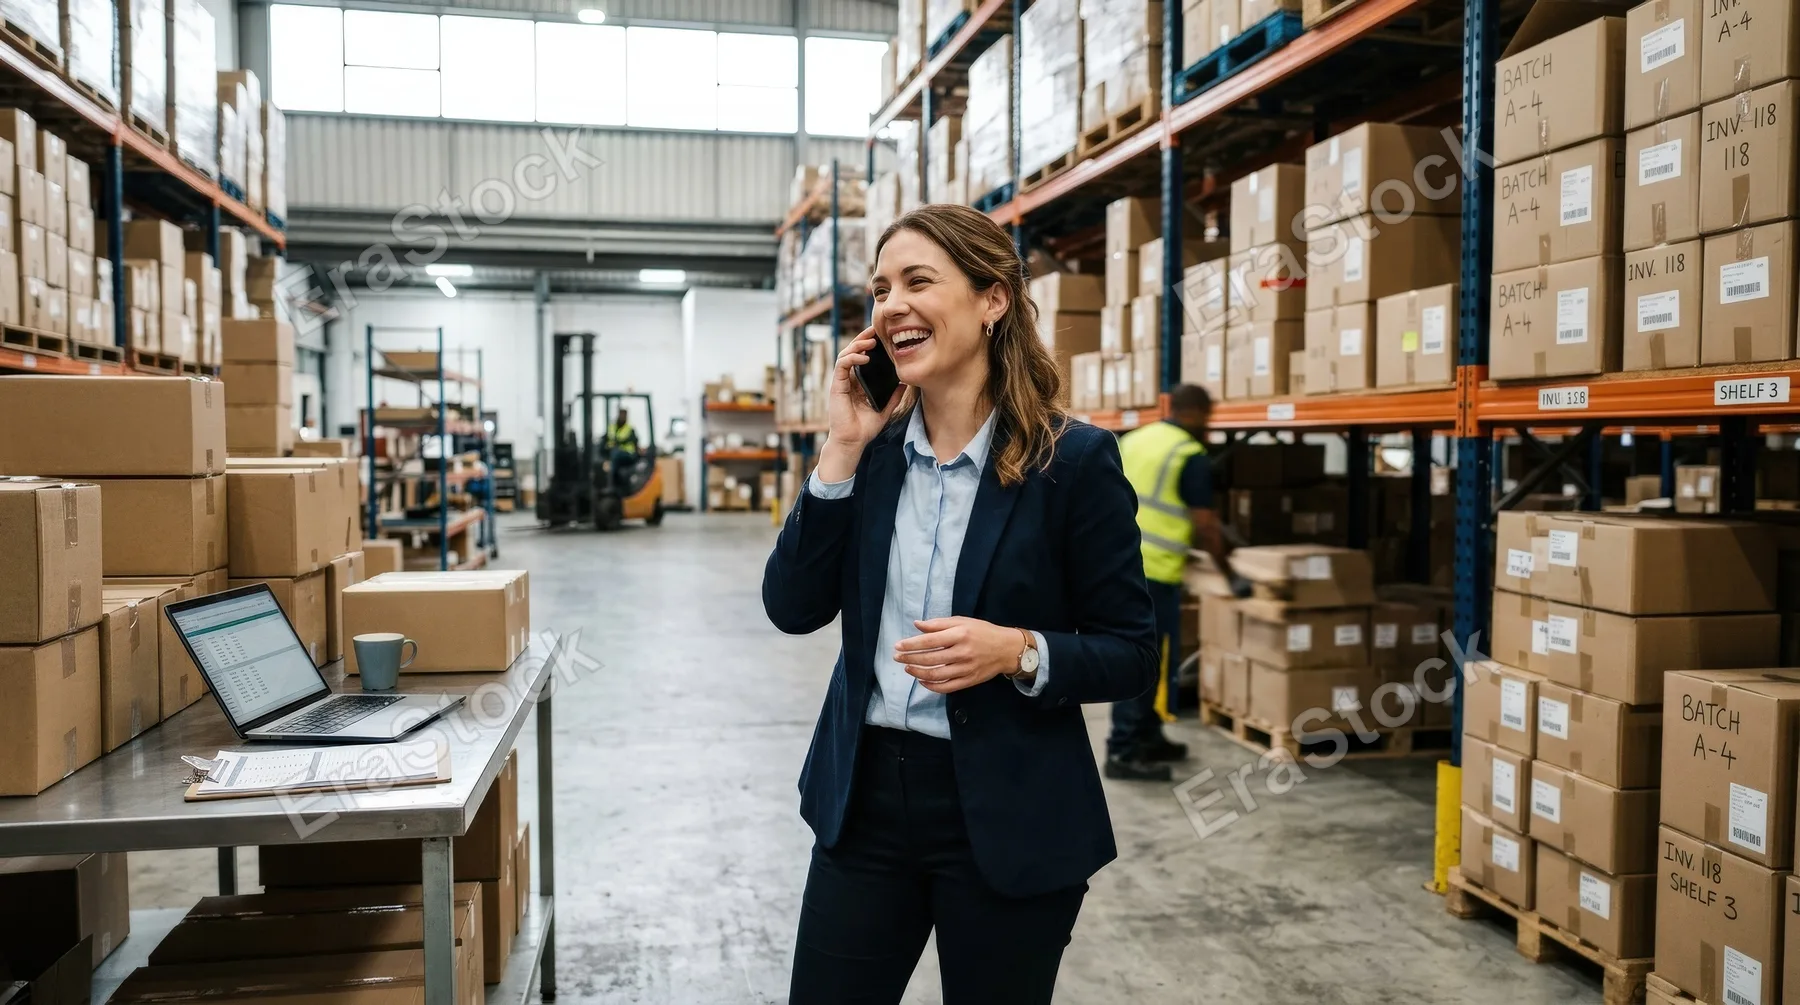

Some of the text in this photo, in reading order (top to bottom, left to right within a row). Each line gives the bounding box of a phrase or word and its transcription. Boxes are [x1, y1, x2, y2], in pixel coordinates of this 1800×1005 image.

[1718, 10, 1753, 43] A-4
[1502, 53, 1552, 95] BATCH
[1504, 91, 1544, 127] A-4
[1707, 103, 1778, 142] INV. 118
[1723, 142, 1751, 171] 118
[1501, 165, 1548, 200] BATCH
[1507, 197, 1541, 227] A-4
[1665, 253, 1685, 274] 118
[1498, 281, 1542, 308] BATCH
[1502, 312, 1532, 337] A-4
[1719, 382, 1779, 400] SHELF 3
[1682, 694, 1740, 735] BATCH
[1693, 733, 1737, 770] A-4
[1701, 857, 1722, 884] 118
[1669, 872, 1738, 921] SHELF 3
